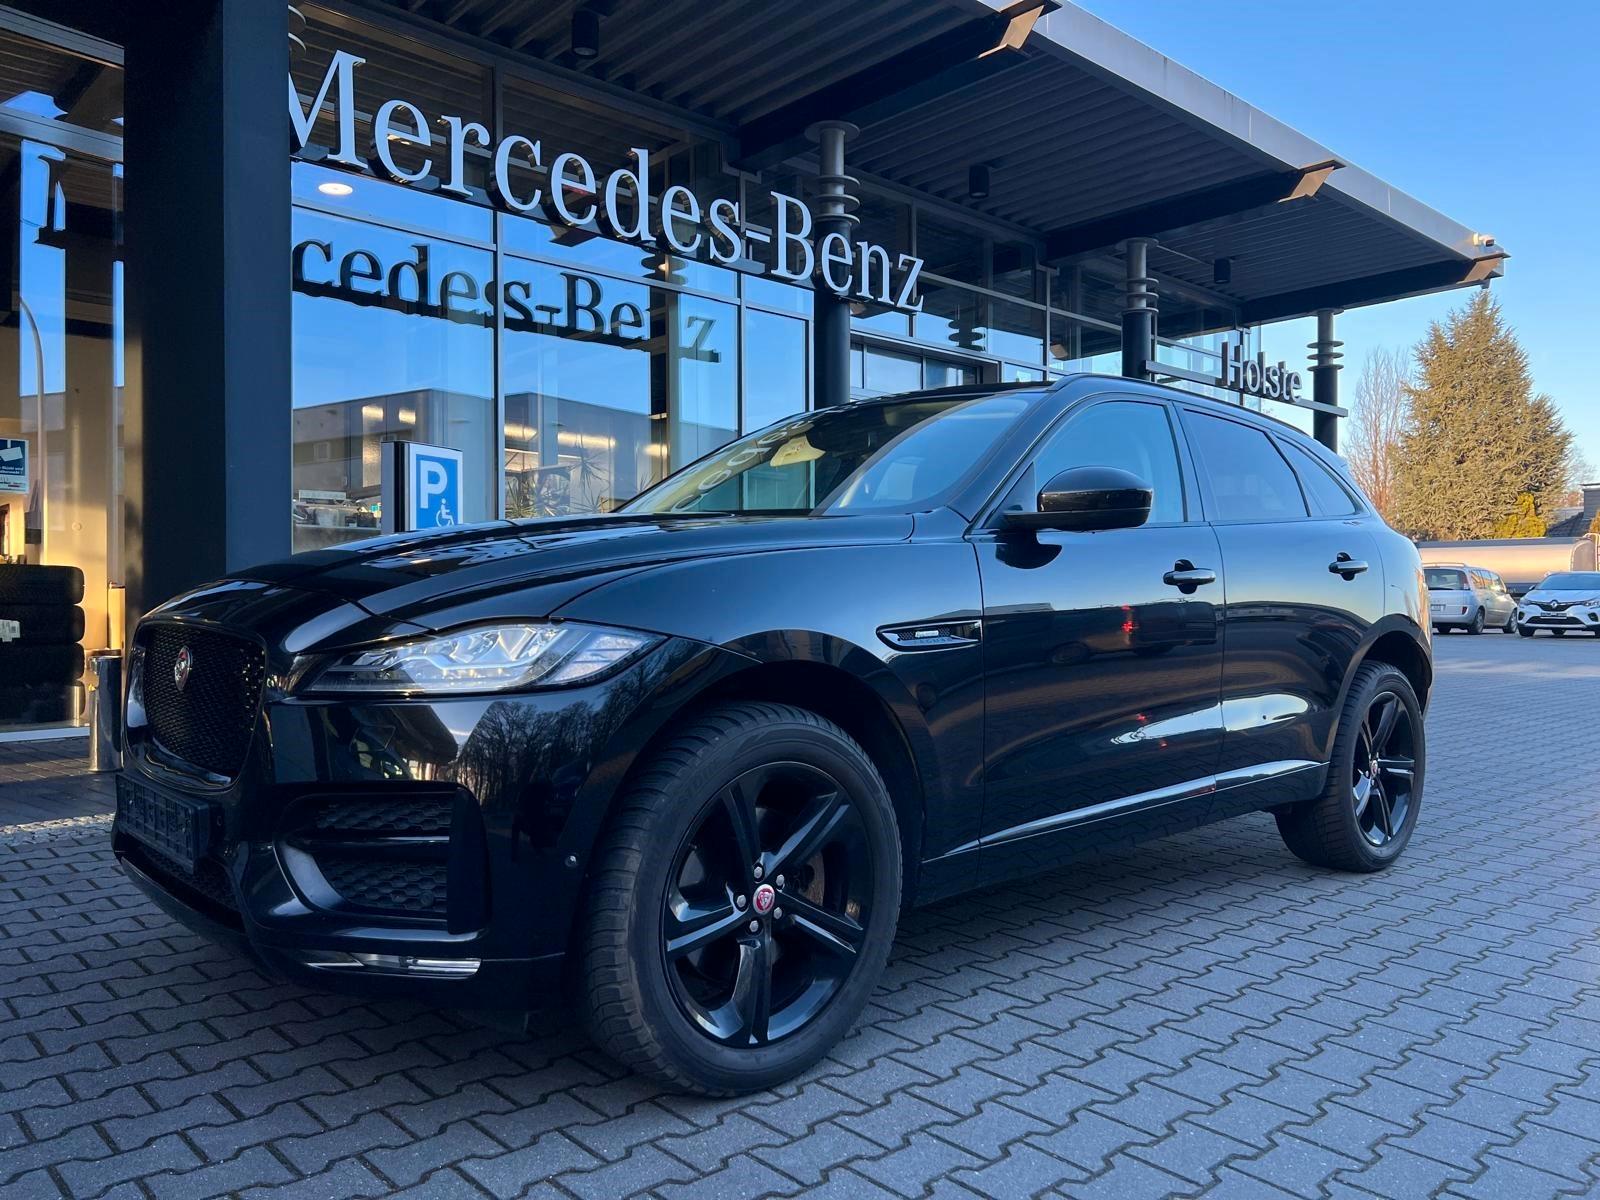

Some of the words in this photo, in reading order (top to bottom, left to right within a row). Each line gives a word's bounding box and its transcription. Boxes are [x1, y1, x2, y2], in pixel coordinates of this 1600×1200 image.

[288, 50, 924, 312] Mercedes-Benz
[1222, 341, 1303, 402] Holste
[420, 459, 448, 509] P
